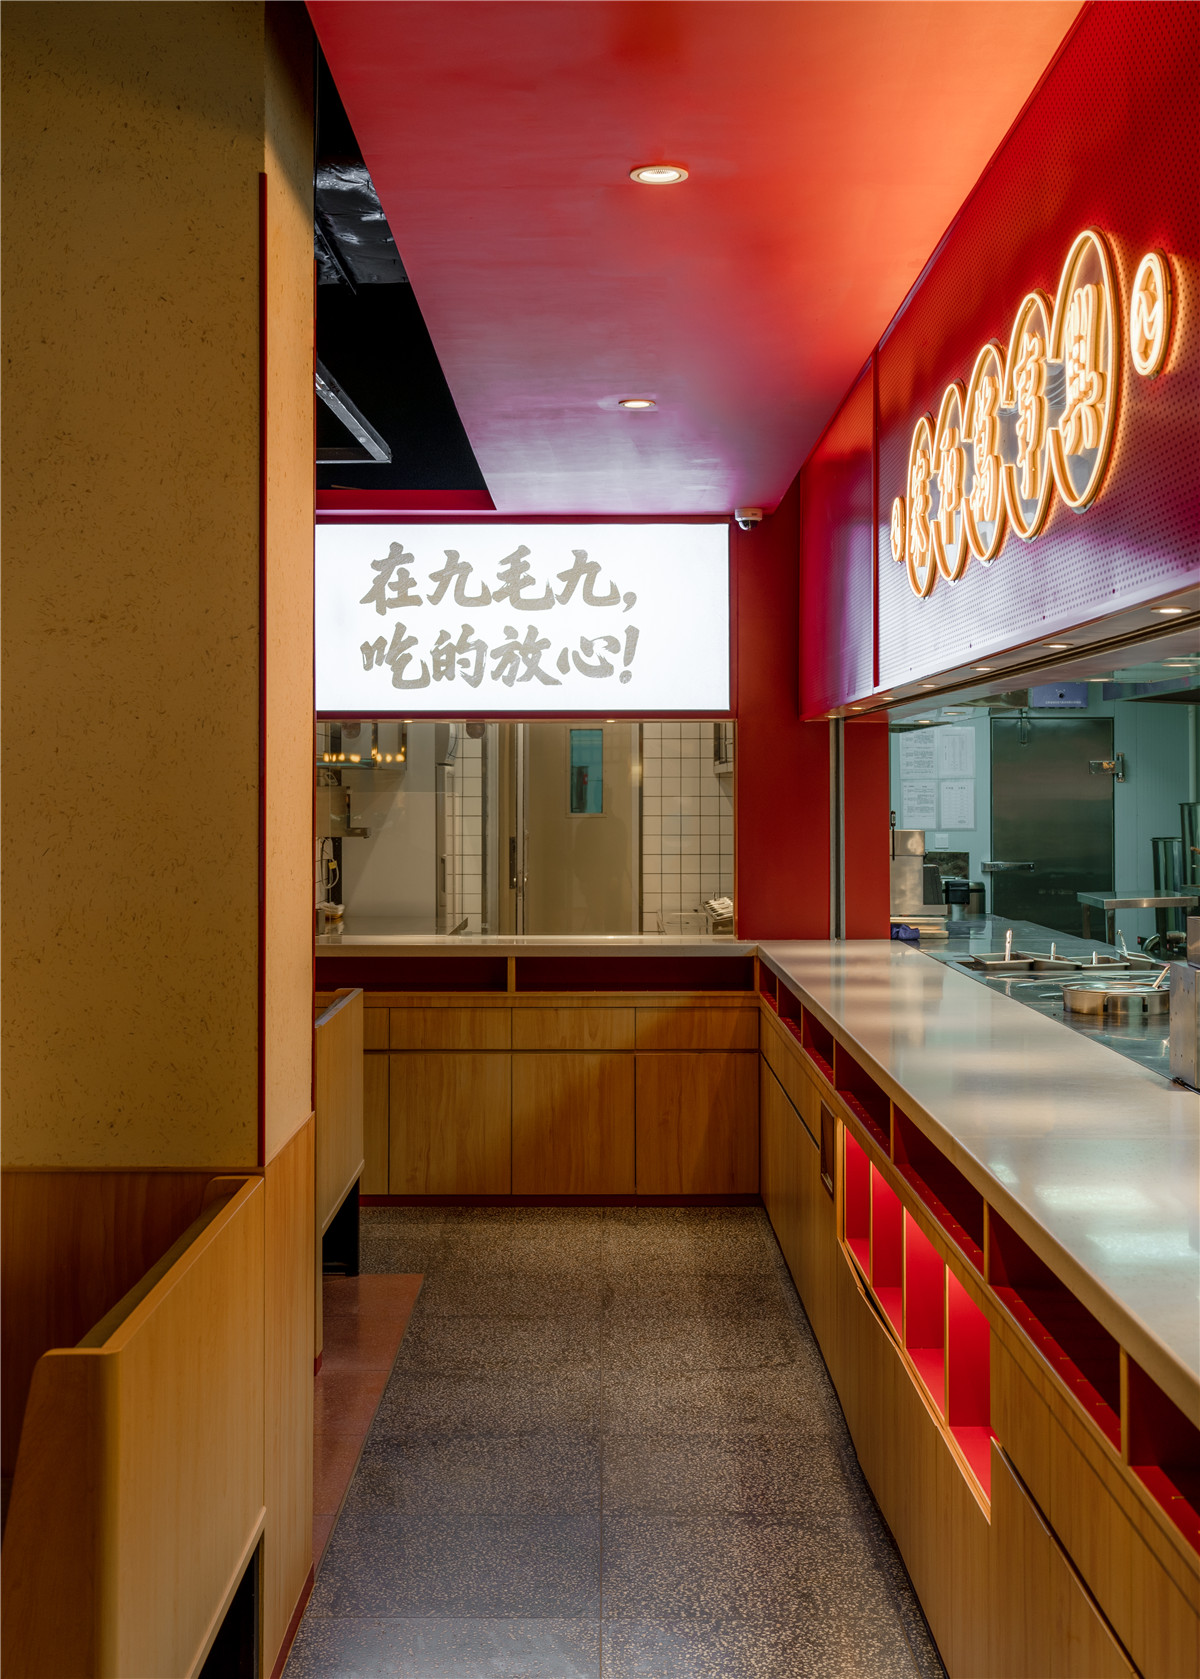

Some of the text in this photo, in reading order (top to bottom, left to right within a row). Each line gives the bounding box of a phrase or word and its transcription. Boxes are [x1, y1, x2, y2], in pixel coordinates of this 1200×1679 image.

[359, 541, 638, 616] 在九毛九，
[359, 621, 640, 690] 吃的放心！
